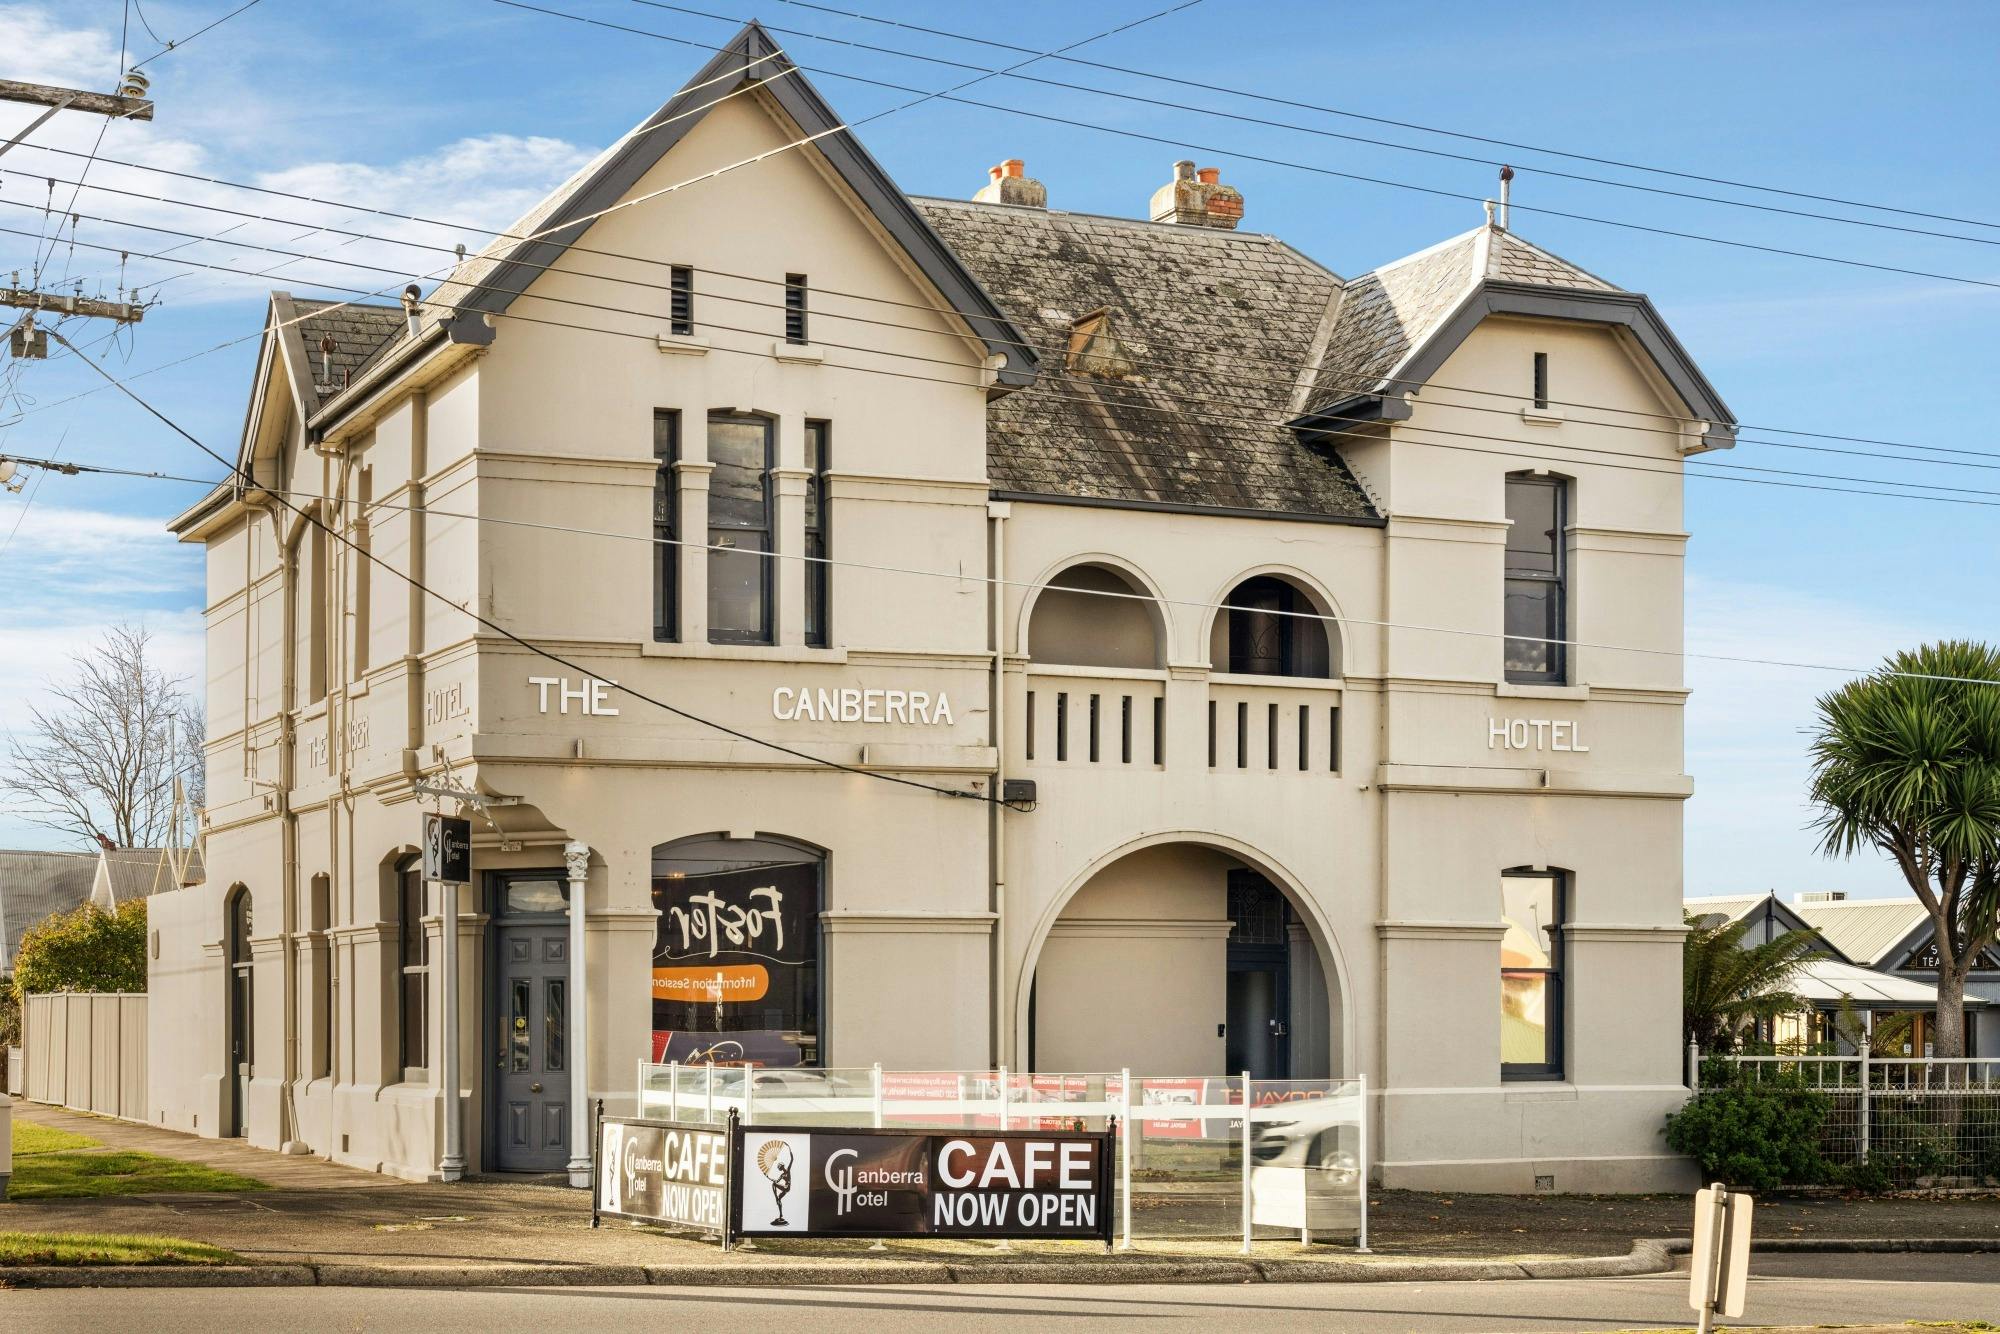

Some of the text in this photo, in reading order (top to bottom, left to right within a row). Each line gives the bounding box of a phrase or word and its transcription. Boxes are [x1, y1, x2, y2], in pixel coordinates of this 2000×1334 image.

[528, 676, 1590, 752] THE CANBERRA HOTEL
[664, 1131, 725, 1184] CAFE
[937, 1140, 1092, 1190] CAFE
[662, 1184, 723, 1225] NOW OPEN
[934, 1193, 1096, 1228] NOW OPEN
